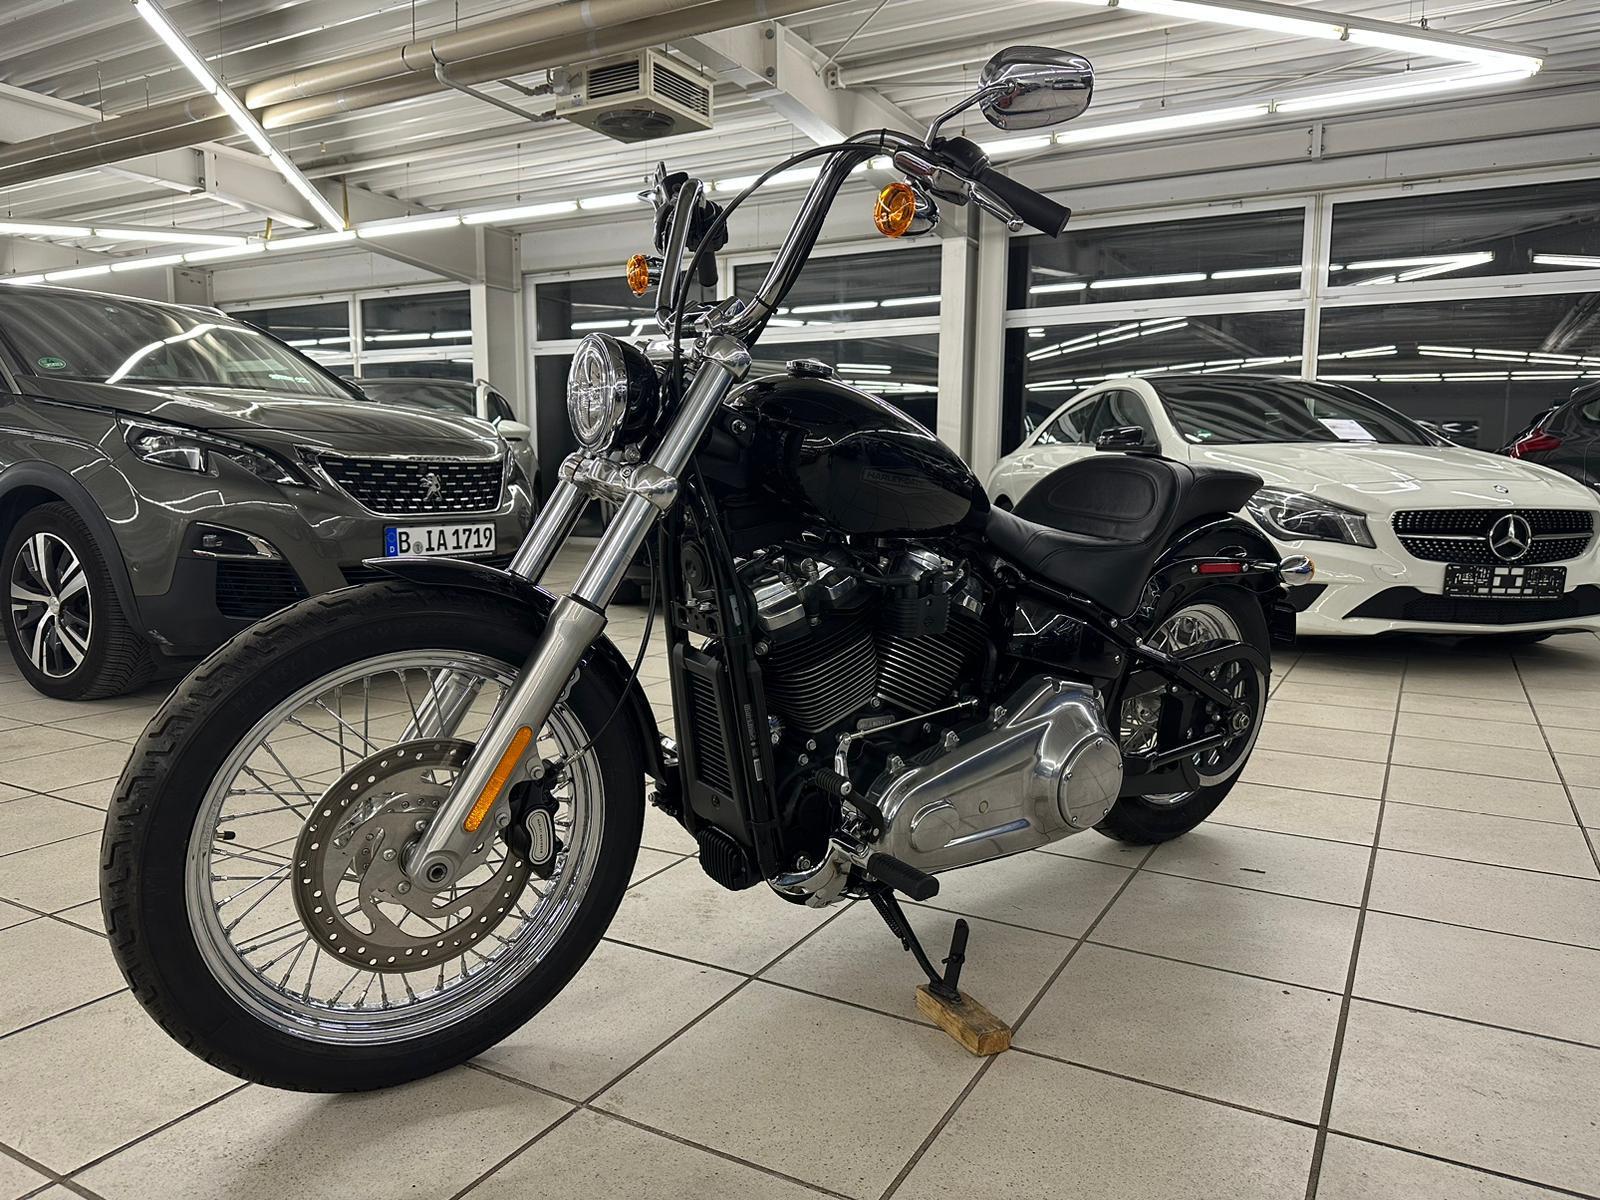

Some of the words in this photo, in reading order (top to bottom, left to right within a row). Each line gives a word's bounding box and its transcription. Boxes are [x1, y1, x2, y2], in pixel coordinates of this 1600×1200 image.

[398, 531, 411, 553] B
[425, 529, 448, 552] IA
[452, 527, 493, 550] 1719
[389, 545, 396, 553] D
